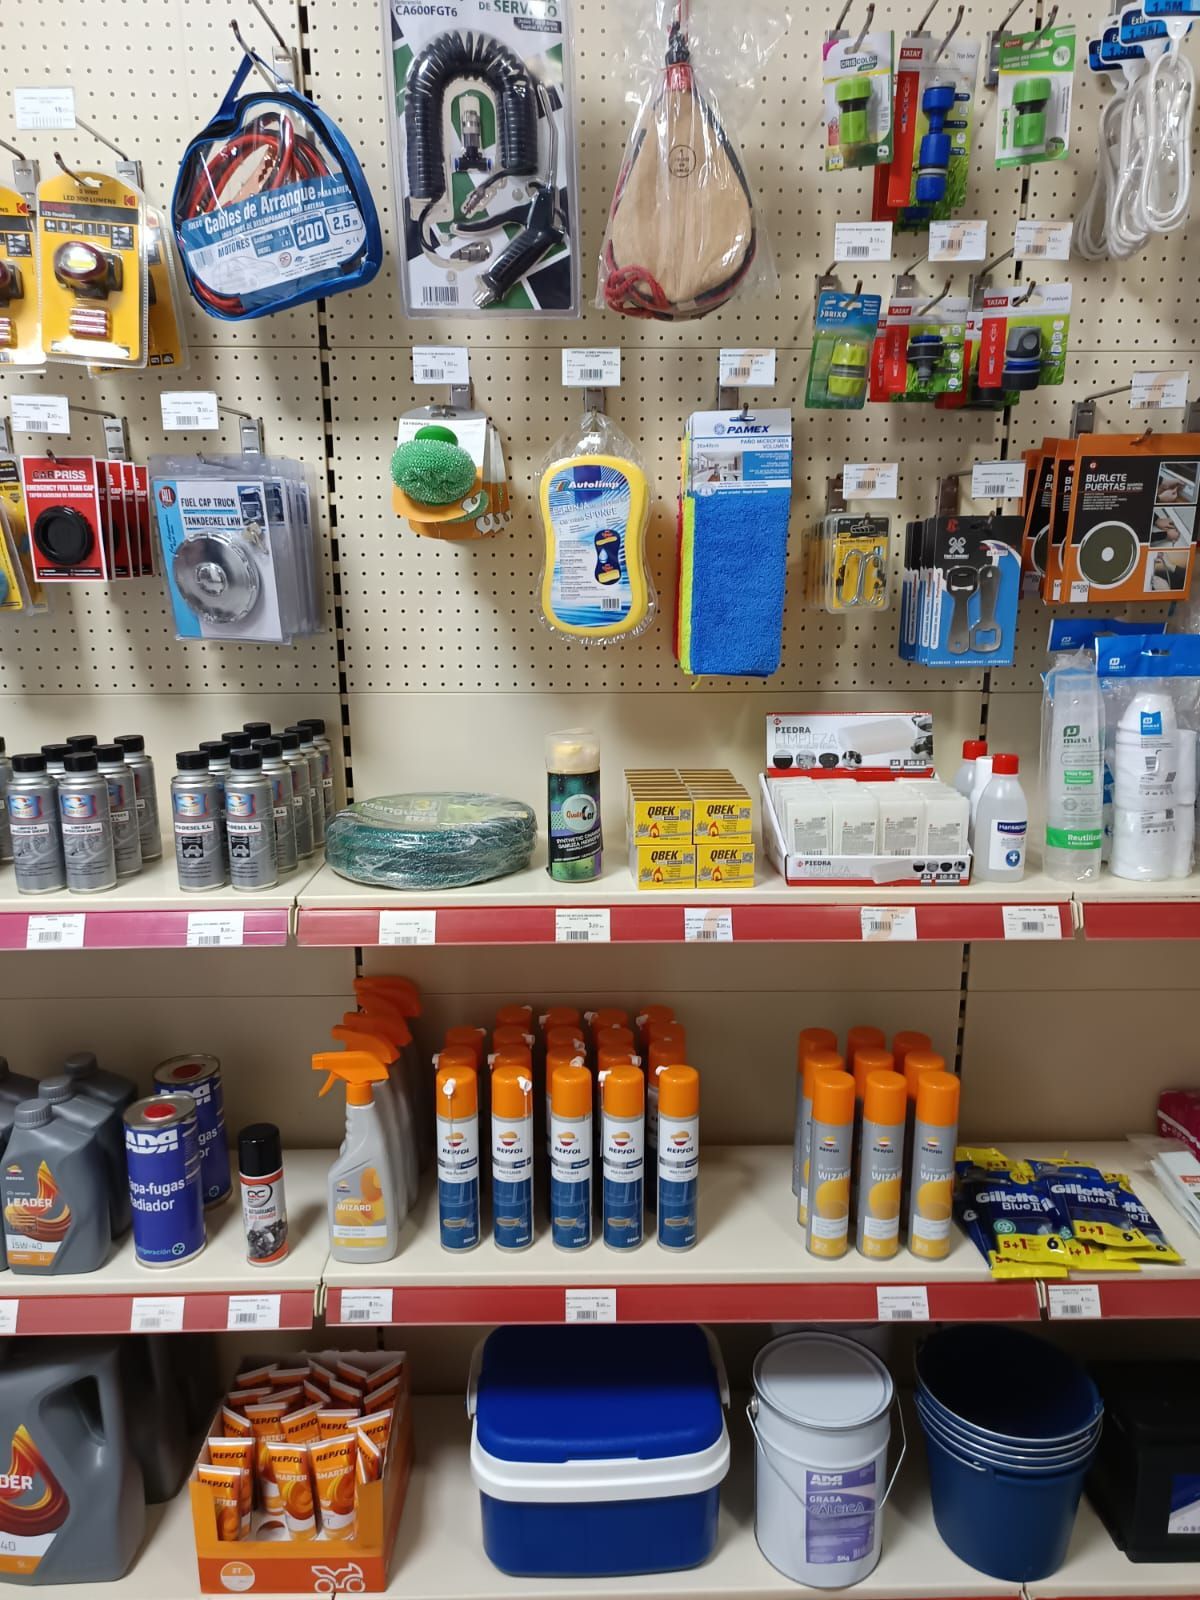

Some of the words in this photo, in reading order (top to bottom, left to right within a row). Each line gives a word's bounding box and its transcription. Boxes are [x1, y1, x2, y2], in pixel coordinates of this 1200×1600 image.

[395, 5, 458, 17] CA600FGT6
[204, 208, 242, 235] Cables
[244, 203, 258, 219] de
[261, 185, 317, 215] Arranque
[296, 219, 326, 247] 200
[727, 425, 770, 434] PAMEX
[1086, 474, 1128, 483] BURLETE
[568, 481, 620, 490] Autolimp
[1085, 483, 1127, 492] PUERTAS
[181, 498, 197, 507] FUEL
[199, 498, 212, 507] CAP
[213, 498, 236, 507] TRUCK
[184, 516, 226, 526] TANKDECKEL
[227, 517, 241, 526] LKW
[775, 726, 812, 734] PIEDRA
[648, 806, 676, 818] QBEK
[707, 805, 735, 817] QBEK
[651, 850, 678, 862] QBEK
[710, 849, 738, 861] QBEK
[496, 1147, 523, 1155] REPSOL
[555, 1147, 581, 1155] REPSOL
[608, 1147, 635, 1155] REPSOL
[666, 1146, 694, 1154] REPSOL
[1051, 1183, 1116, 1198] Gillette
[975, 1190, 1041, 1205] Gillette
[1077, 1194, 1107, 1205] Blue
[7, 1198, 53, 1208] LEADER
[337, 1203, 372, 1212] WIZARD
[1002, 1202, 1031, 1211] Blue
[1046, 1237, 1061, 1251] 6
[271, 1455, 304, 1464] REPSOL
[316, 1449, 351, 1461] REPSOL
[202, 1479, 234, 1488] REPSOL
[809, 1495, 842, 1503] GRASA
